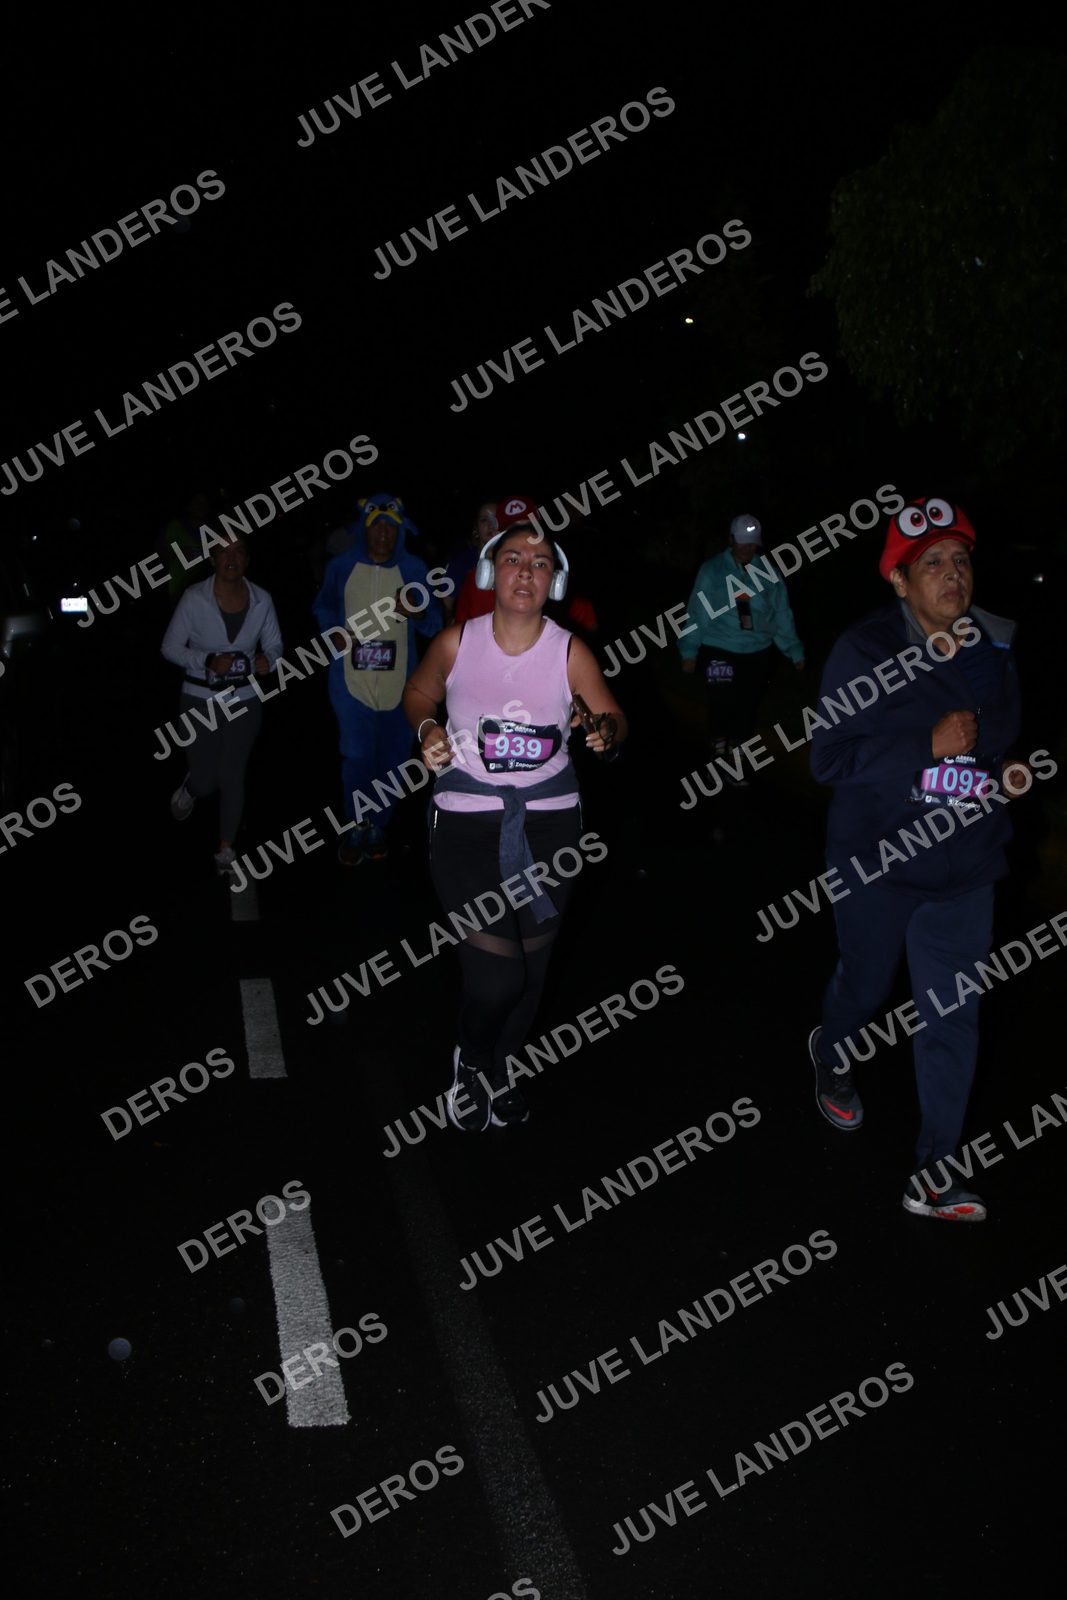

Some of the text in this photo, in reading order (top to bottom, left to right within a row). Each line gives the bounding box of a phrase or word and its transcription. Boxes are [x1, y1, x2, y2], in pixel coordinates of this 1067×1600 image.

[357, 647, 392, 662] 1744
[494, 735, 542, 759] 939
[926, 766, 988, 797] 1097
